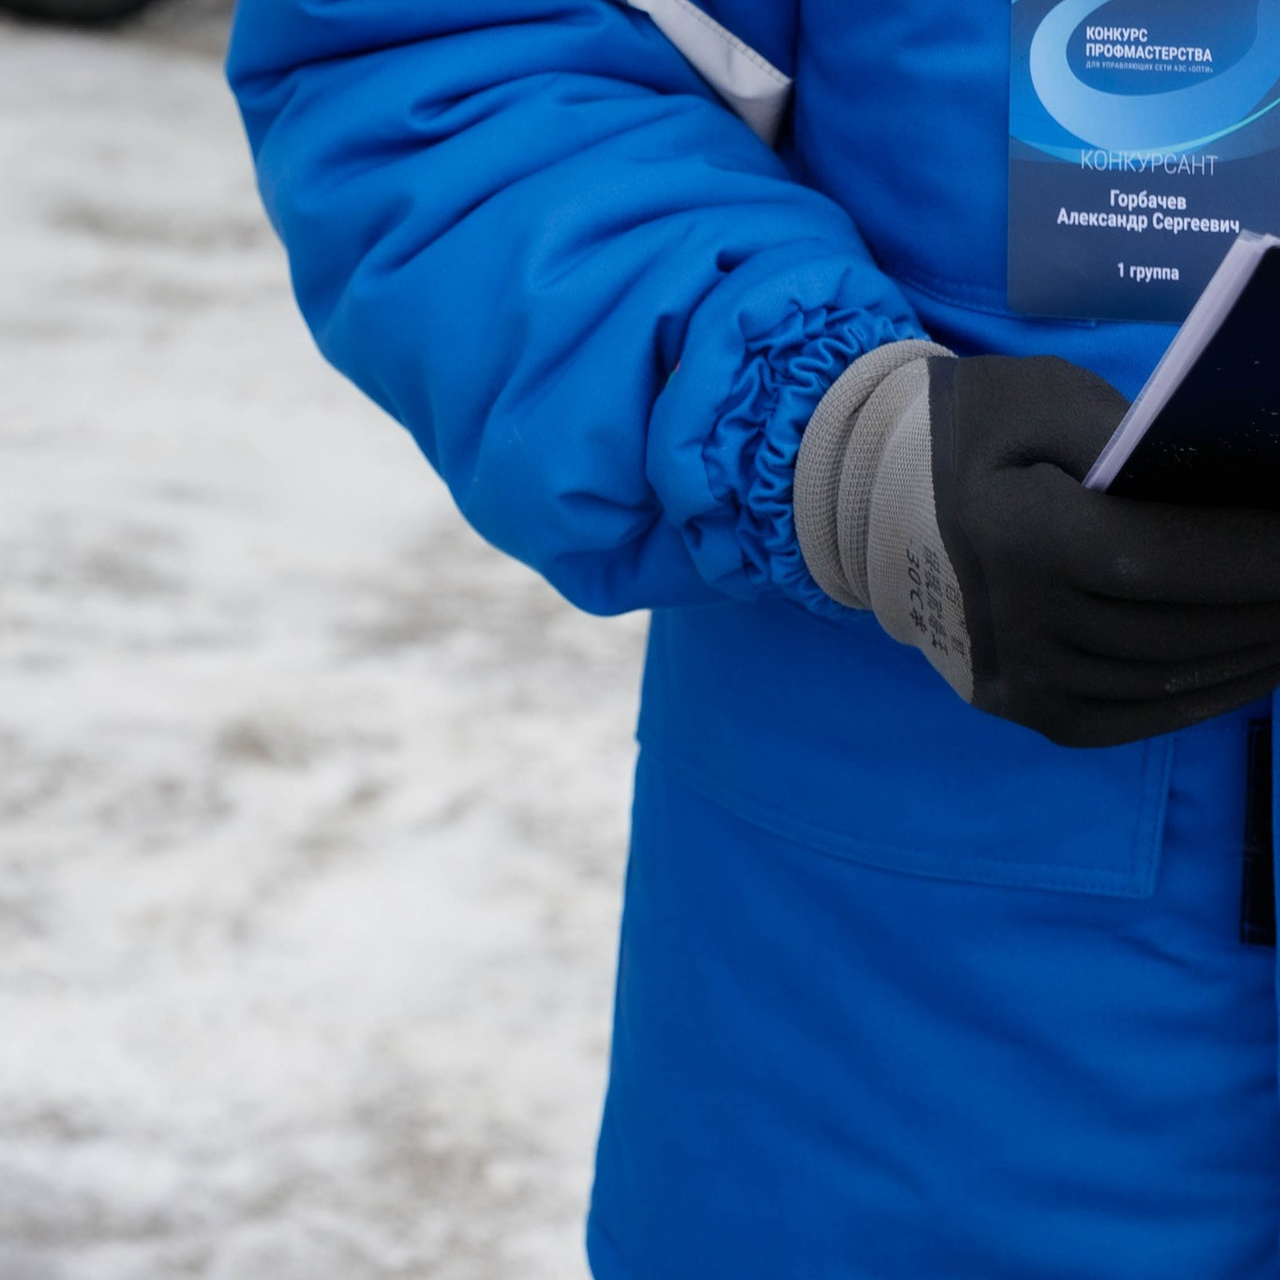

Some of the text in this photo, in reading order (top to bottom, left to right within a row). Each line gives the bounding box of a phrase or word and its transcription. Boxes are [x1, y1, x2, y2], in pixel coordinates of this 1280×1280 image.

[1086, 26, 1148, 43] КОНКУРС
[1085, 43, 1213, 62] ПРОФМАСТЕРСТВА
[1085, 60, 1100, 69] ДЛЯ
[1102, 61, 1153, 71] УПРАВЛЯЮЩИХ
[1154, 64, 1172, 72] СЕТИ
[1173, 65, 1187, 73] АЗС
[1080, 148, 1219, 177] КОНКУРСАНТ
[1109, 189, 1187, 212] Горбачев
[1056, 207, 1240, 235] Александр Сергеевич
[1117, 262, 1180, 283] 1 группа
